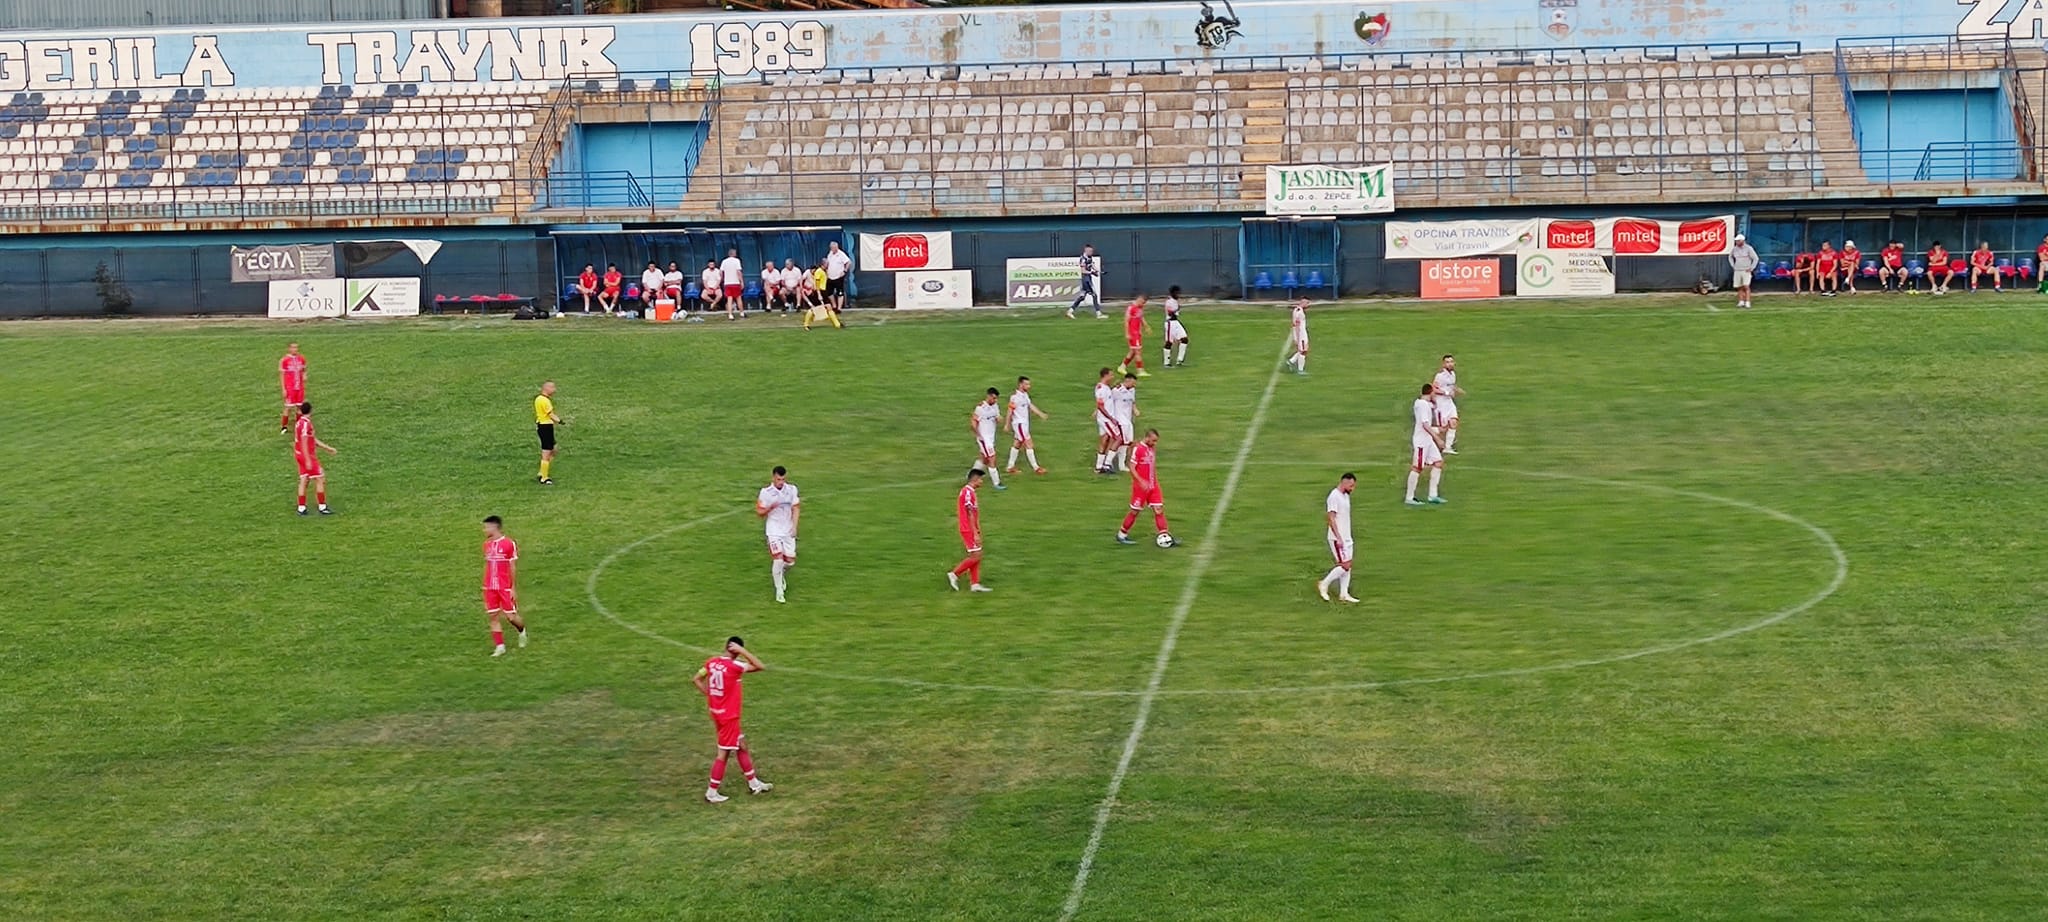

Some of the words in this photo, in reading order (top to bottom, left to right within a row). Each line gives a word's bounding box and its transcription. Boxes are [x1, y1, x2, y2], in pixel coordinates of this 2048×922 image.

[960, 13, 982, 26] VL
[307, 25, 618, 84] TRAVNIK
[689, 20, 827, 76] 1989
[1274, 168, 1355, 201] JASMIN
[1357, 167, 1386, 199] M
[1323, 191, 1353, 201] ŽEPČE
[1462, 227, 1511, 238] TRAVNIK
[1552, 230, 1590, 244] m:tel
[1617, 229, 1655, 243] m:tel
[1682, 228, 1721, 242] m:tel
[887, 244, 923, 258] m:tel
[1434, 242, 1455, 251] Visit
[1457, 240, 1491, 250] Travnik
[234, 251, 295, 270] TECTA
[1014, 271, 1054, 279] BENZINSKA
[1013, 283, 1054, 298] ABA
[276, 296, 335, 312] IZVOR
[709, 667, 724, 690] 20
